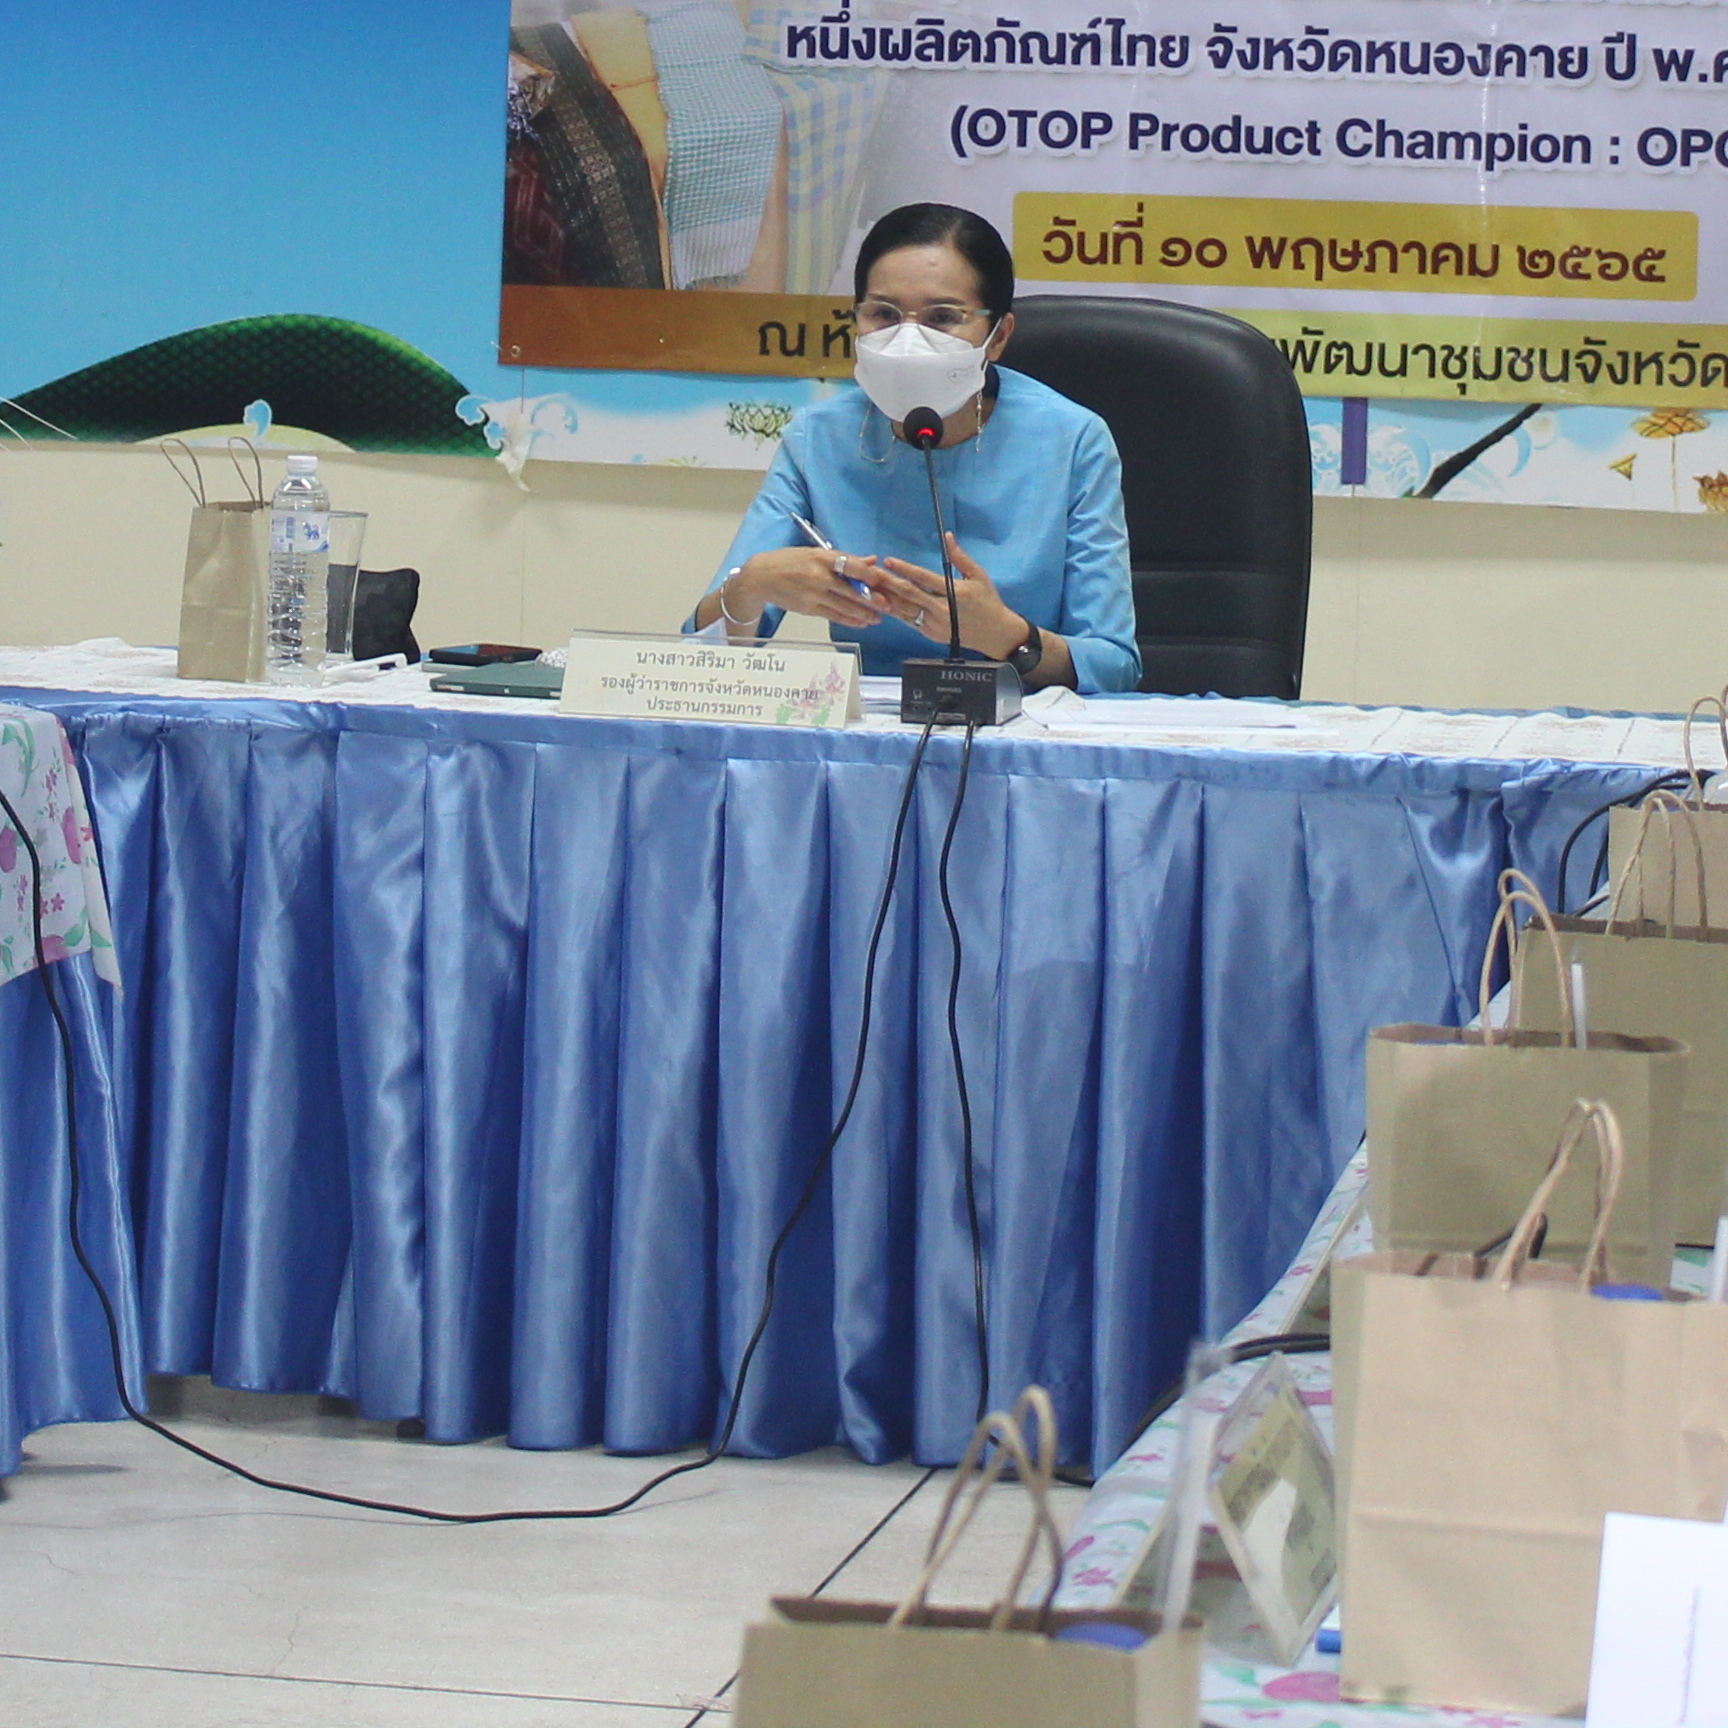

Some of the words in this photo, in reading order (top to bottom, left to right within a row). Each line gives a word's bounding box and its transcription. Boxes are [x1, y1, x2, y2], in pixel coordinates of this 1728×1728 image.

[1206, 23, 1592, 80] จังหวัดหนองคาย
[1602, 32, 1637, 82] ปี
[950, 103, 1114, 158] (OTOP
[1128, 113, 1322, 156] Product
[1335, 117, 1592, 168] Champion
[1041, 202, 1145, 267] วันที่
[1158, 233, 1228, 268] ๑๐
[1245, 234, 1500, 280] พฤษภาคม
[1515, 244, 1667, 283] ๒๕๖๕
[757, 320, 807, 357] ณ
[636, 650, 736, 669] นางสาวสิริมา
[600, 673, 819, 702] รองผู้ว่าราชการจังหวัดหนองคาย
[940, 670, 993, 683] HONIC
[646, 697, 764, 718] ประธานกรรมการ
